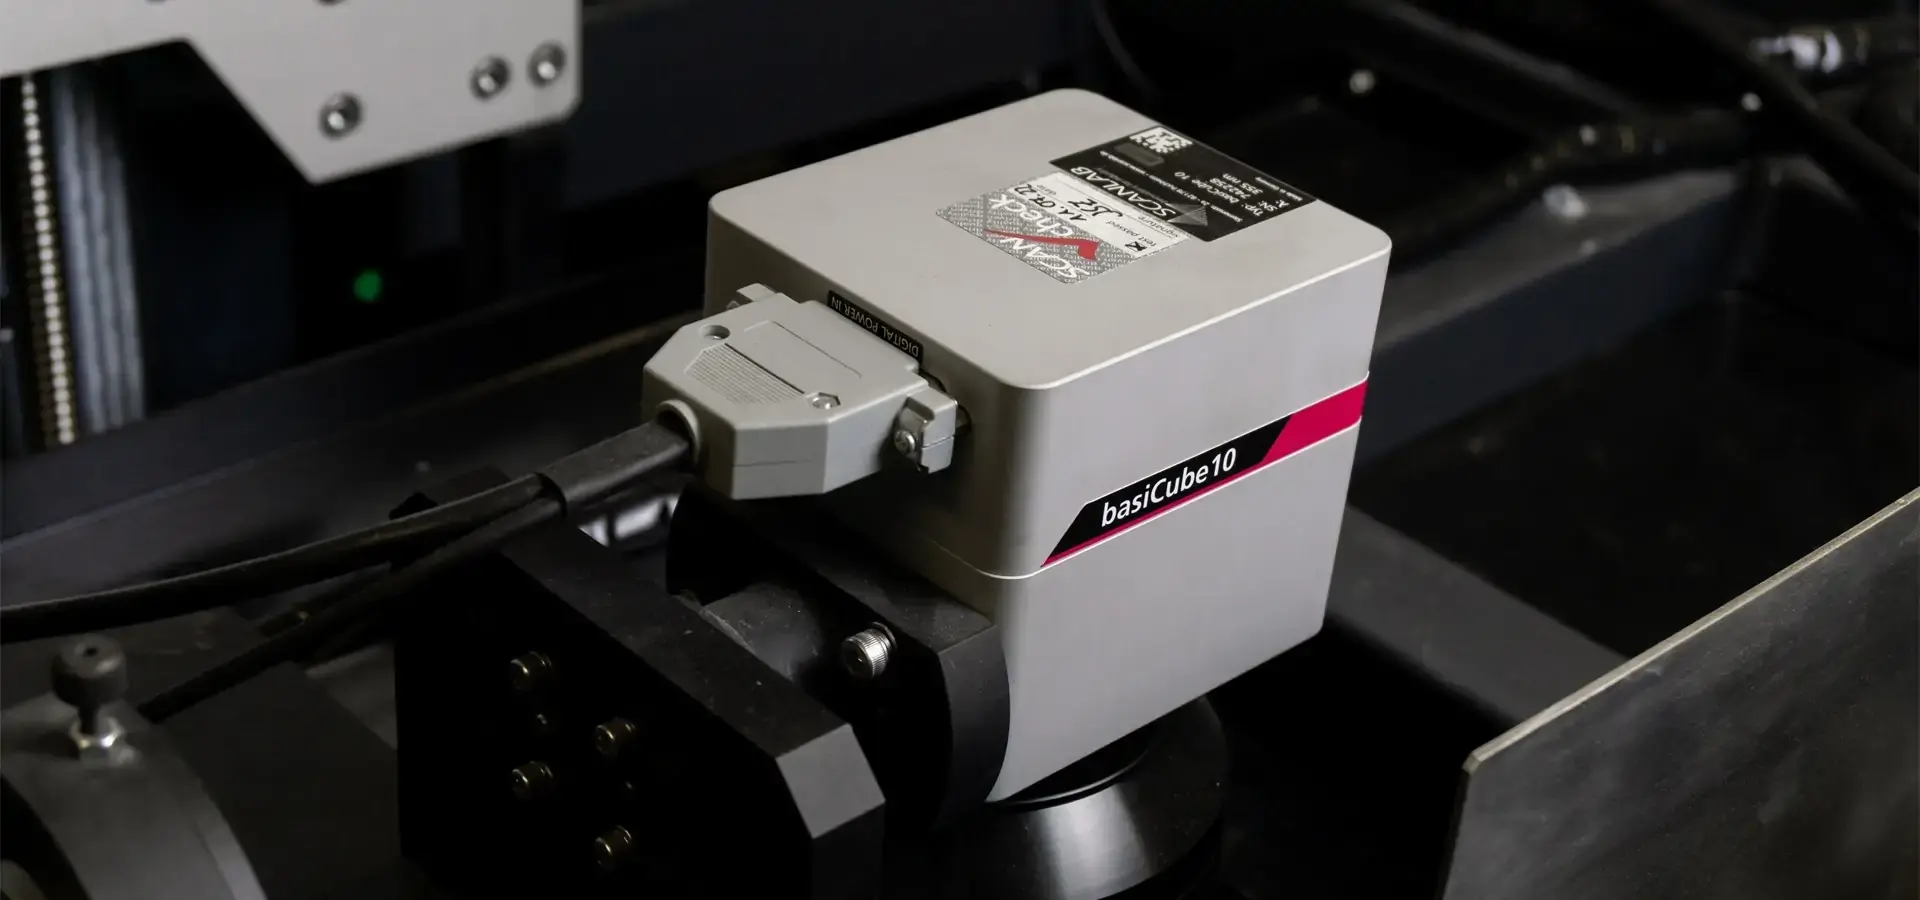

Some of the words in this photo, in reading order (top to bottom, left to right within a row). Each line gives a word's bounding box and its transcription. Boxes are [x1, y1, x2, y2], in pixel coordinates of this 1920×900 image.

[1174, 171, 1191, 180] 10
[1222, 173, 1242, 184] nm
[1070, 166, 1176, 217] SCANLAB
[1191, 179, 1240, 204] basiCube
[1240, 182, 1264, 195] 355
[989, 194, 1074, 236] check
[1241, 202, 1264, 216] Typ:
[1258, 200, 1279, 212] SN:
[1106, 220, 1140, 237] passed
[1137, 215, 1179, 238] signature
[1138, 236, 1157, 246] test
[1000, 237, 1090, 278] SCAN
[830, 296, 842, 311] IN
[844, 304, 880, 334] POWER
[880, 325, 919, 358] DIGITAL
[1101, 464, 1210, 528] basiCube
[1211, 447, 1237, 477] 10
